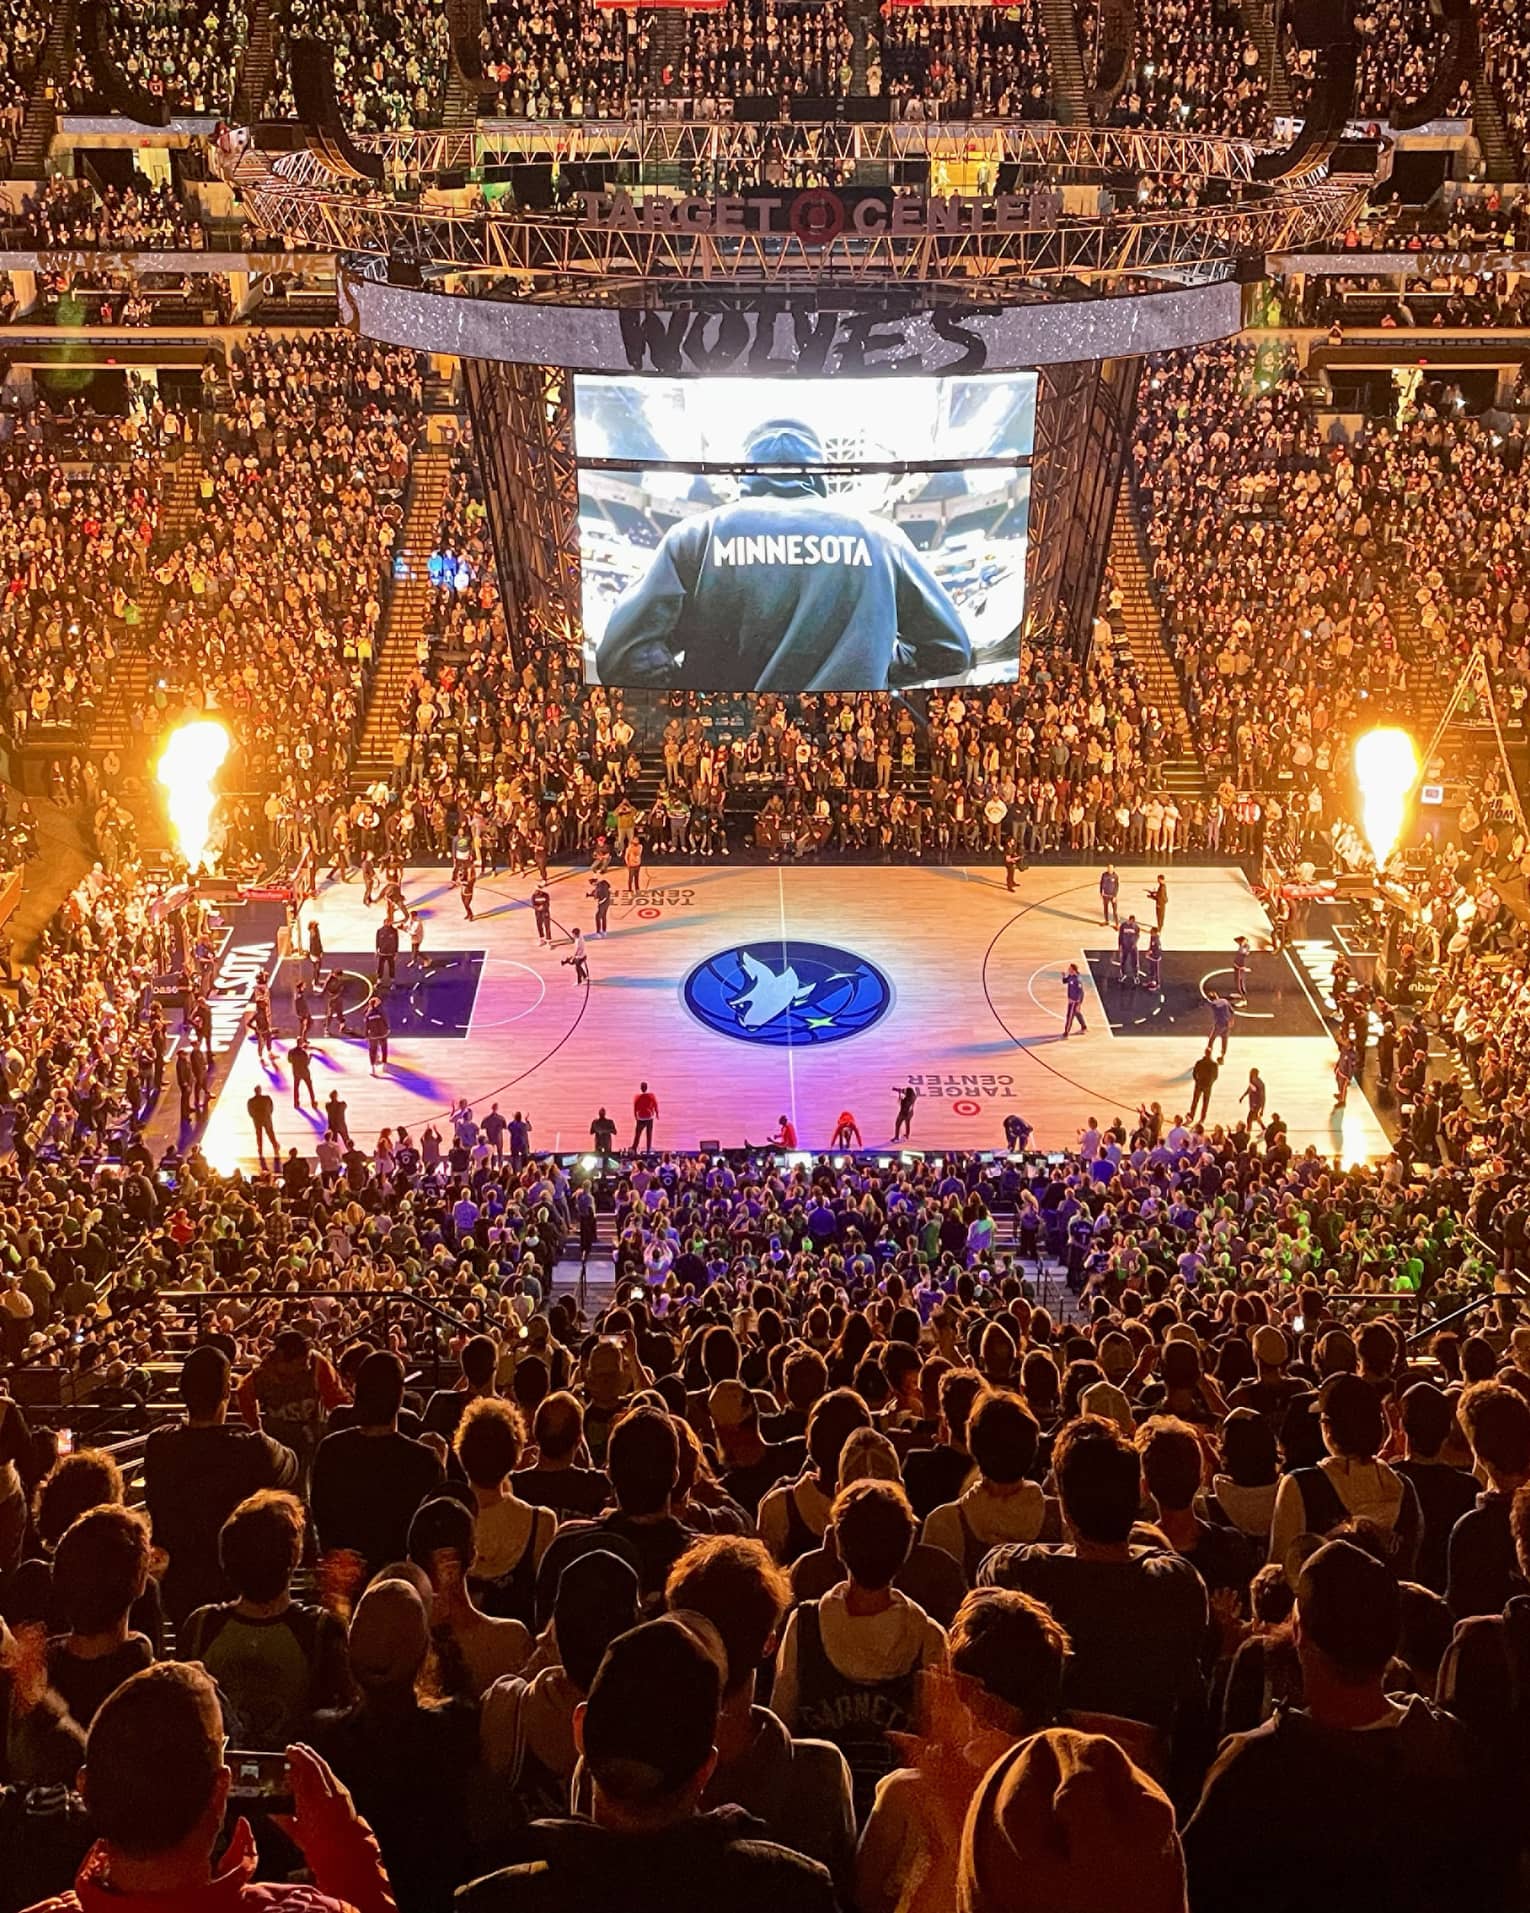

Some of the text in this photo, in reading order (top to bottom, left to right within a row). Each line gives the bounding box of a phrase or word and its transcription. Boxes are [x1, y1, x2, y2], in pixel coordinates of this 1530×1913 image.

[578, 195, 1058, 235] TARGET CENTER
[619, 307, 1003, 374] WOLVES
[713, 535, 873, 567] MINNESOTA
[610, 898, 694, 906] TARGET
[907, 1075, 1015, 1085] CENTER
[915, 1087, 1018, 1097] TARGET
